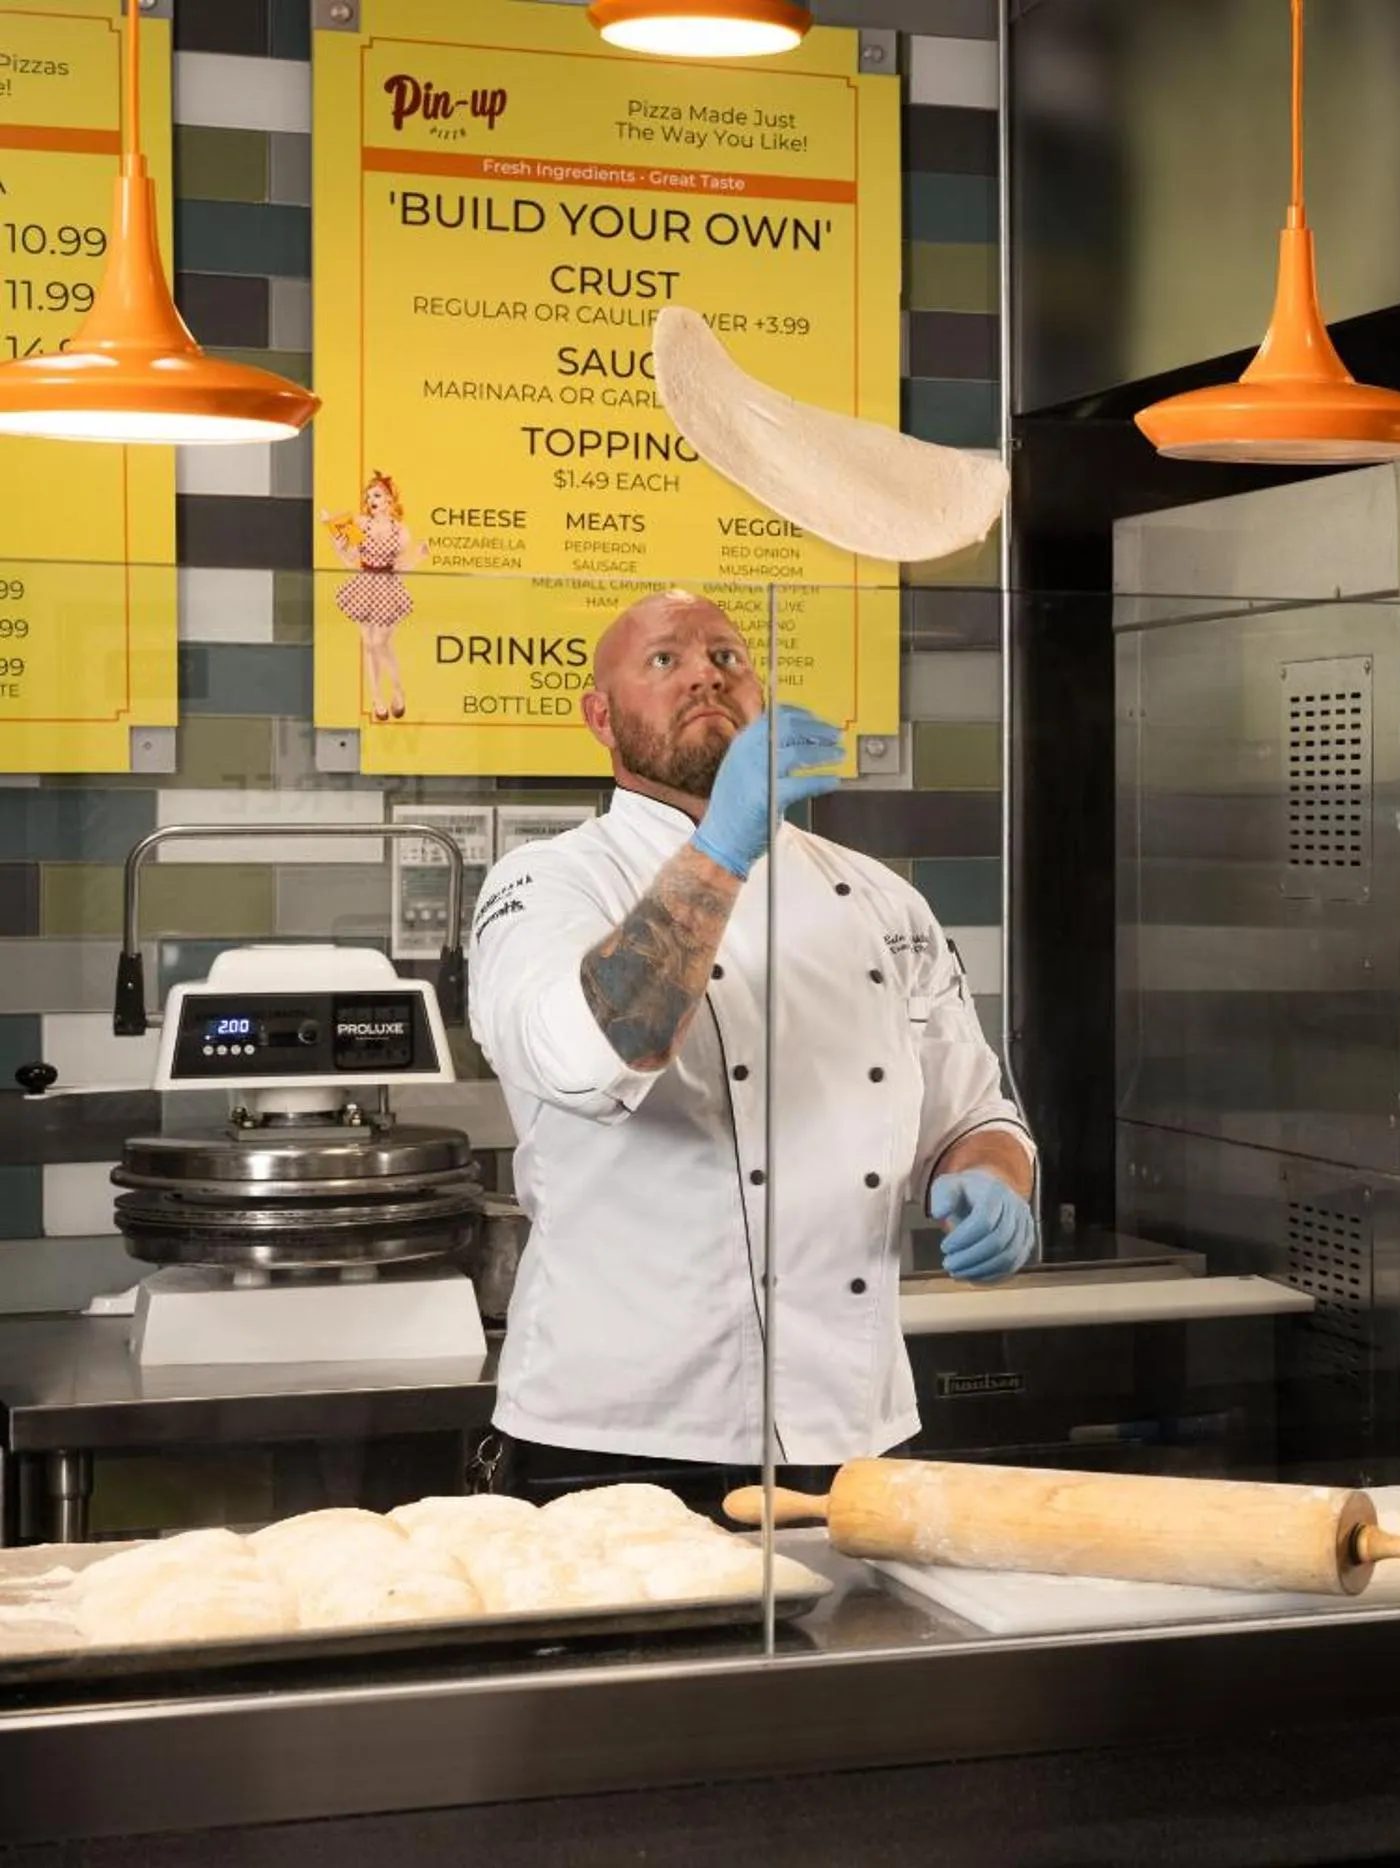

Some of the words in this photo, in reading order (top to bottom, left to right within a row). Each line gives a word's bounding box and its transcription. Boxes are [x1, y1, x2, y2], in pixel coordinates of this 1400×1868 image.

[383, 74, 507, 131] Pin-up
[628, 99, 682, 121] Pizza
[689, 104, 748, 125] Made
[753, 109, 797, 130] Just
[615, 121, 655, 141] The
[661, 125, 709, 149] Way
[714, 129, 754, 149] You
[760, 133, 808, 152] Like!
[483, 159, 531, 175] Fresh
[537, 162, 636, 183] Ingredients
[650, 170, 697, 188] Great
[701, 174, 745, 190] Taste
[390, 191, 546, 233] 'BUILD
[560, 202, 691, 243] YOUR
[705, 211, 832, 251] OWN'
[4, 223, 107, 257] 10.99
[550, 265, 680, 299] CRUST
[4, 279, 95, 313] 11.99
[413, 296, 528, 321] REGULAR
[535, 303, 569, 324] OR
[576, 305, 748, 332] CAULIFWER
[754, 316, 811, 335] +3.99
[557, 346, 656, 380] SAUC
[423, 380, 553, 405] MARINARA
[559, 386, 595, 406] OR
[601, 388, 664, 409] GARL
[521, 426, 700, 462] TOPPING
[553, 468, 609, 490] $1.49
[616, 472, 680, 492] EACH
[430, 507, 527, 529] CHEESE
[566, 512, 645, 533] MEATS
[717, 517, 804, 537] VEGGIE
[428, 536, 526, 550] MOZZARELLA
[564, 541, 647, 554] PEPPERONI
[721, 546, 750, 558] RED
[754, 547, 801, 560] ONION
[572, 559, 638, 573] SAUSAGE
[719, 564, 804, 577] MUSHROOM
[585, 597, 619, 609] HAM
[436, 635, 588, 667] DRINKS
[530, 671, 596, 690] SODA
[463, 695, 573, 716] BOTTLED
[337, 1022, 404, 1036] PROLUXE
